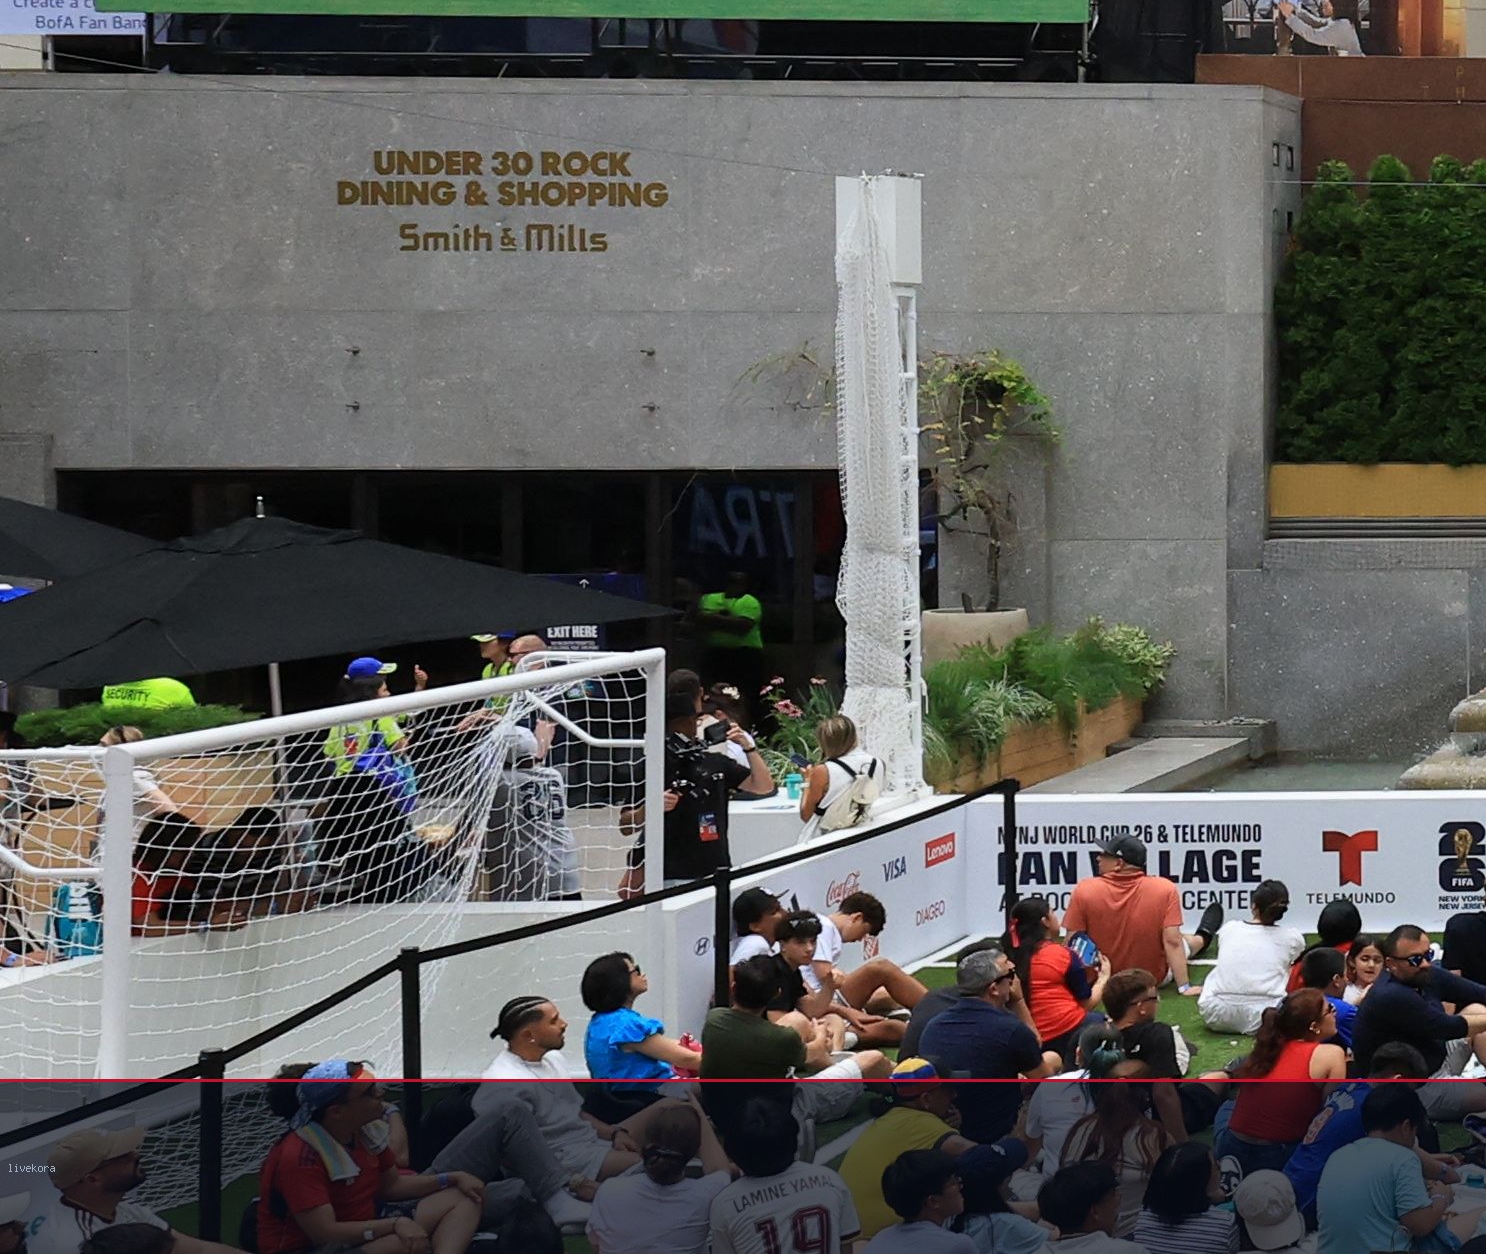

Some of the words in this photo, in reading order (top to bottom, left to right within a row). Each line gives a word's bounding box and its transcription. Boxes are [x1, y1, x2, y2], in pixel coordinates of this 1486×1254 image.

[35, 15, 74, 29] BofA
[79, 15, 107, 29] Fan
[374, 150, 484, 176] UNDER
[491, 151, 534, 176] 30
[541, 151, 632, 177] ROCK
[337, 180, 457, 206] DINING
[464, 181, 489, 206] &
[497, 181, 669, 207] SHOPPING
[399, 223, 493, 252] Smith
[500, 227, 517, 252] &
[526, 223, 608, 252] Mills
[547, 626, 570, 638] EXIT
[572, 625, 598, 638] HERE
[105, 688, 151, 703] SECURITY
[1043, 825, 1096, 845] WORLD
[1135, 825, 1152, 844] 26
[1158, 825, 1168, 843] &
[1173, 824, 1261, 843] TELEMUNDO
[927, 839, 954, 861] Lenovo
[883, 855, 907, 882] VISA
[1452, 877, 1474, 887] FIFA
[1439, 895, 1457, 903] NEW
[915, 900, 945, 926] DIAGEO
[733, 1183, 790, 1213] LAMINE
[789, 1175, 835, 1193] YAMAL
[754, 1204, 831, 1254] 19
